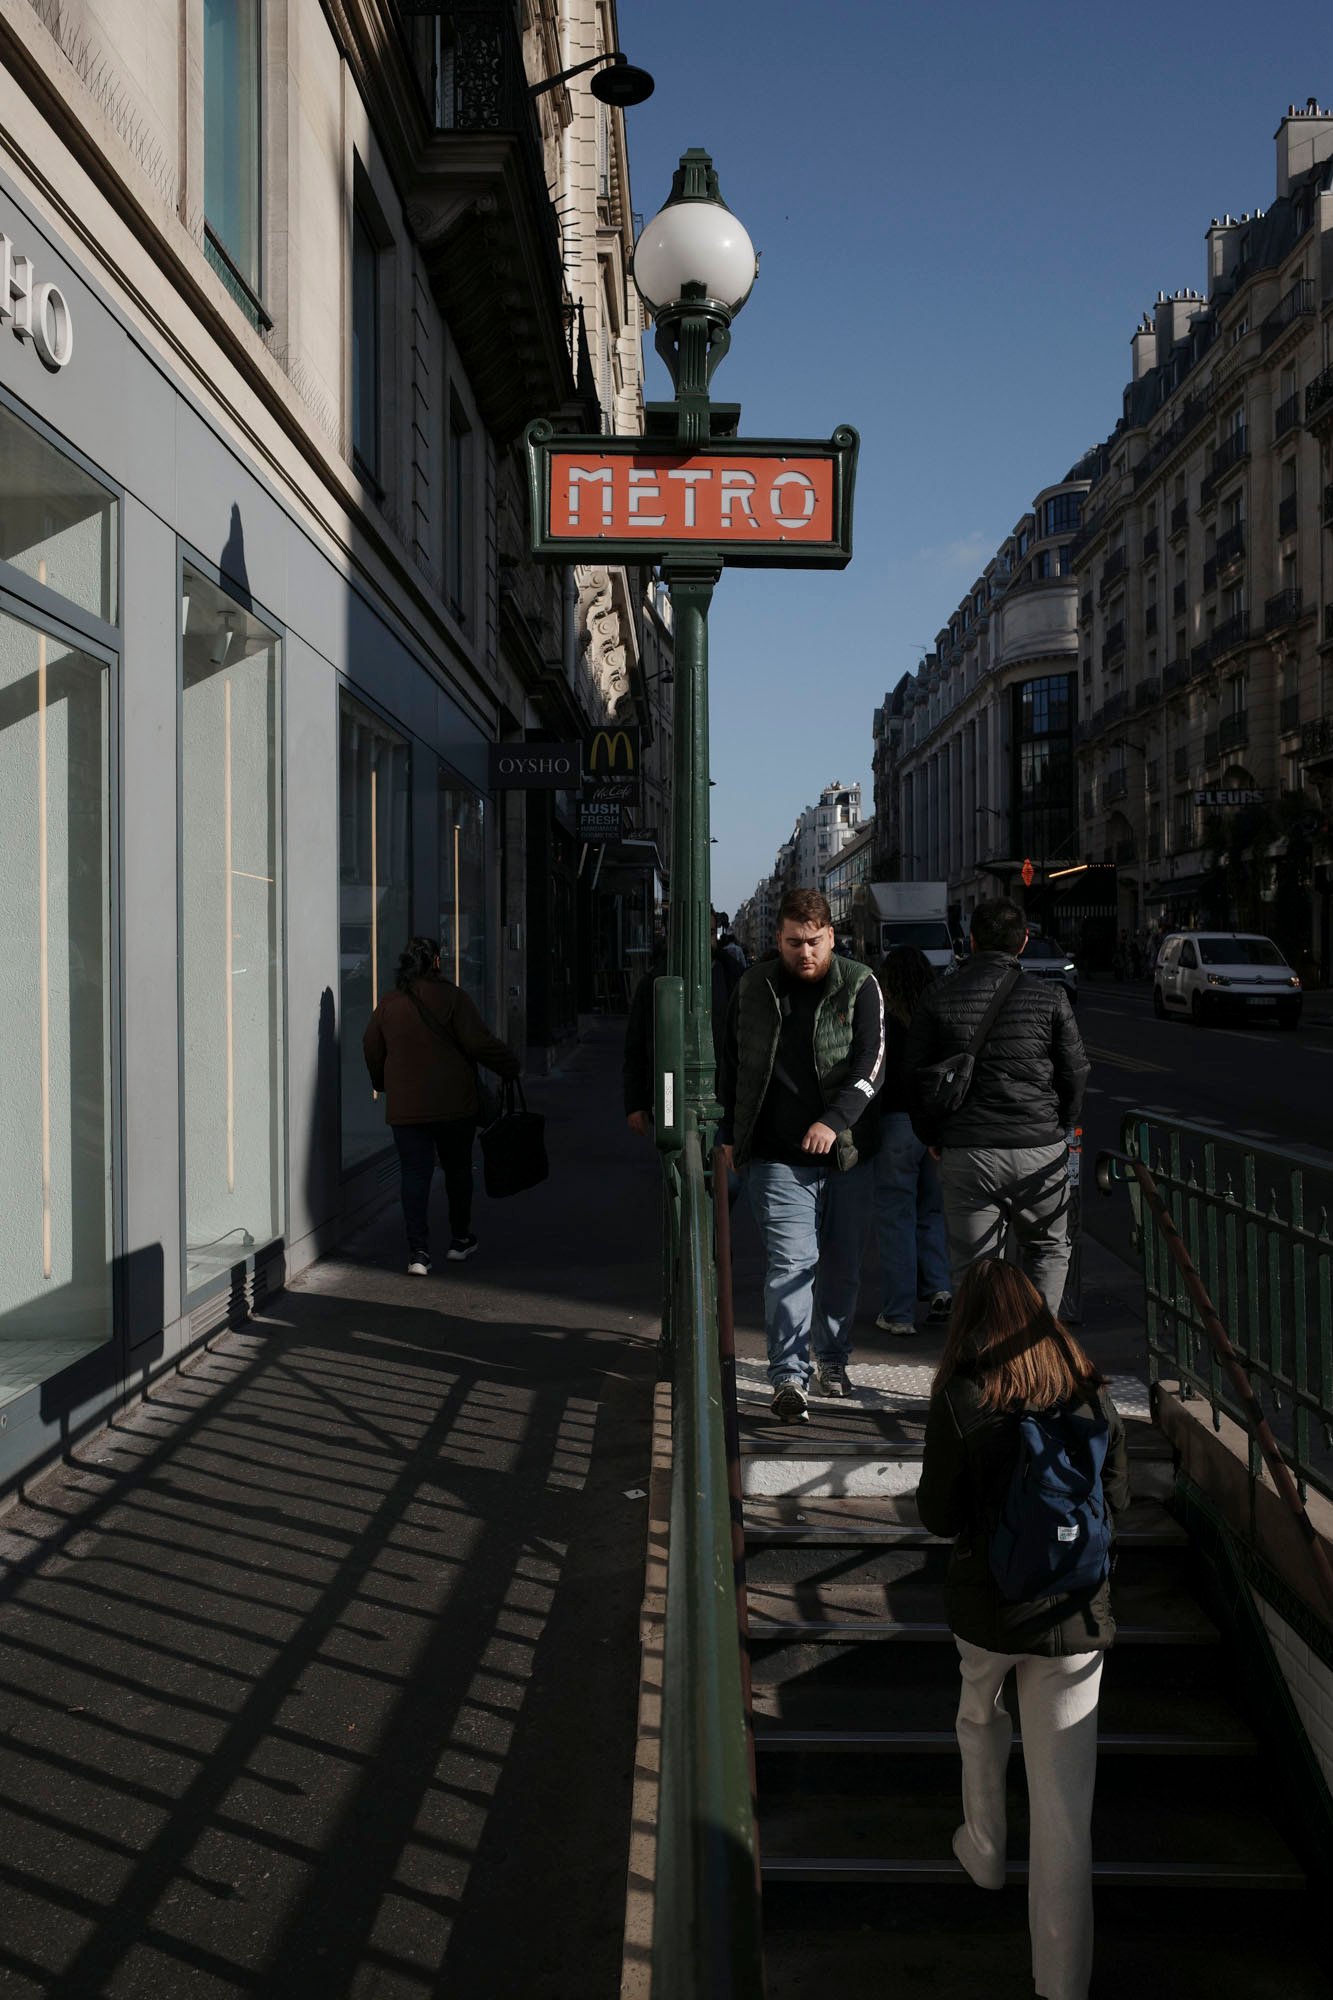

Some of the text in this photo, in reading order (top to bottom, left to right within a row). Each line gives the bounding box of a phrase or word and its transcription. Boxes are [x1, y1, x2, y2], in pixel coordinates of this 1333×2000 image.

[568, 467, 815, 529] METRO
[498, 757, 570, 774] OYSHO
[1195, 790, 1264, 804] FLEURS
[580, 803, 620, 814] LUSH
[580, 815, 620, 825] FRESH
[854, 1078, 875, 1098] NIKE
